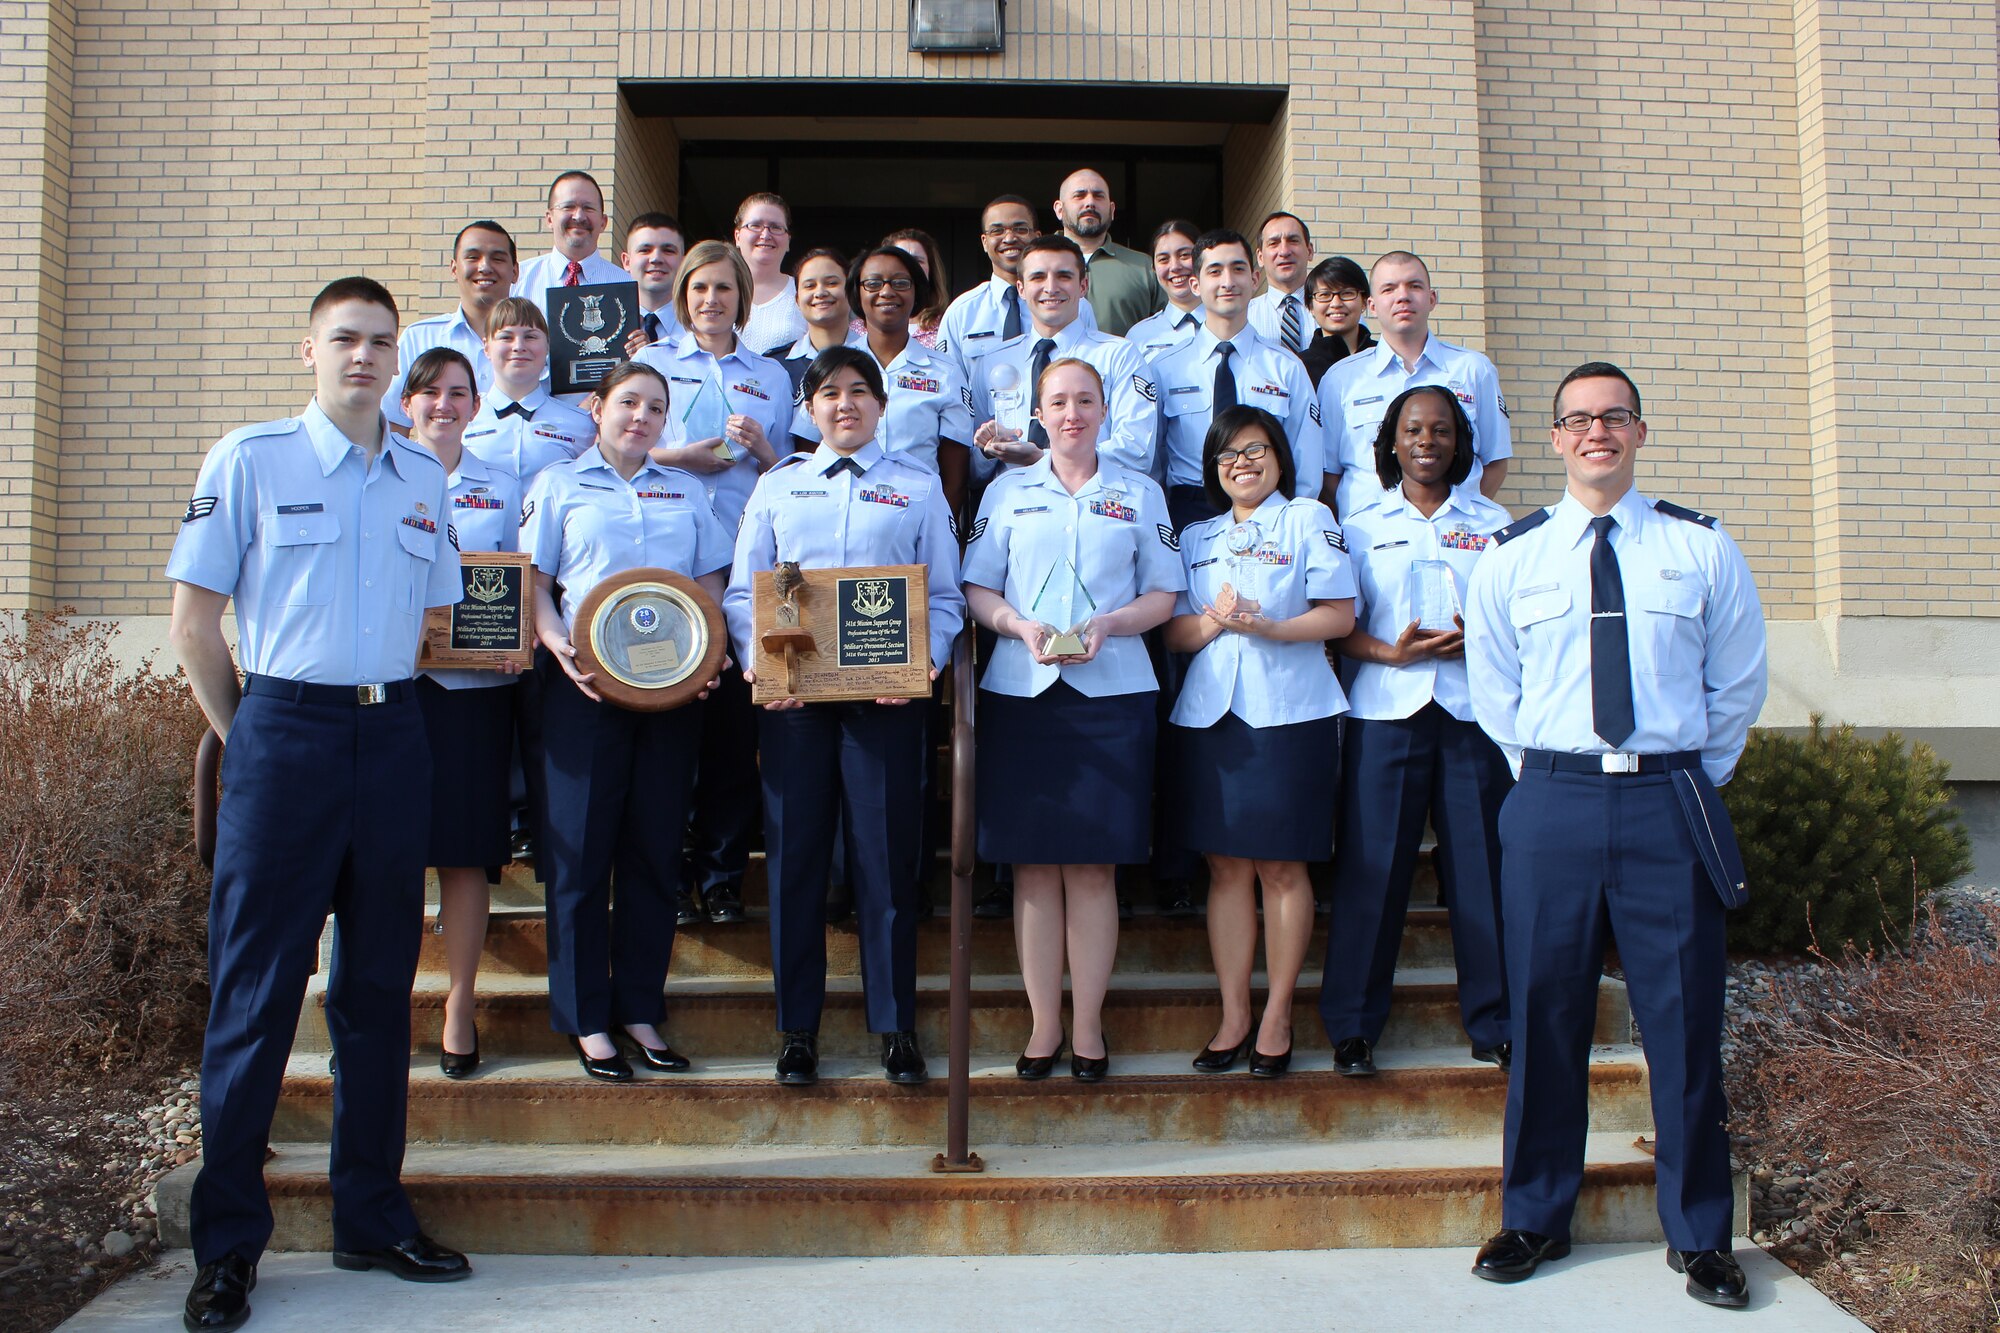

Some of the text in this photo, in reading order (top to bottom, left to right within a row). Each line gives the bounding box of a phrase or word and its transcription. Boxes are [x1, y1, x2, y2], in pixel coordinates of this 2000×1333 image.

[487, 604, 503, 612] Support
[503, 604, 516, 613] Group
[856, 619, 873, 627] Mission
[872, 619, 889, 628] Support
[888, 618, 902, 627] Group
[456, 625, 476, 634] Military
[477, 625, 500, 633] Personnel
[847, 629, 868, 637] Professional
[843, 641, 905, 651] Military Personnel Section
[868, 650, 884, 658] Support
[884, 649, 903, 657] Squadron
